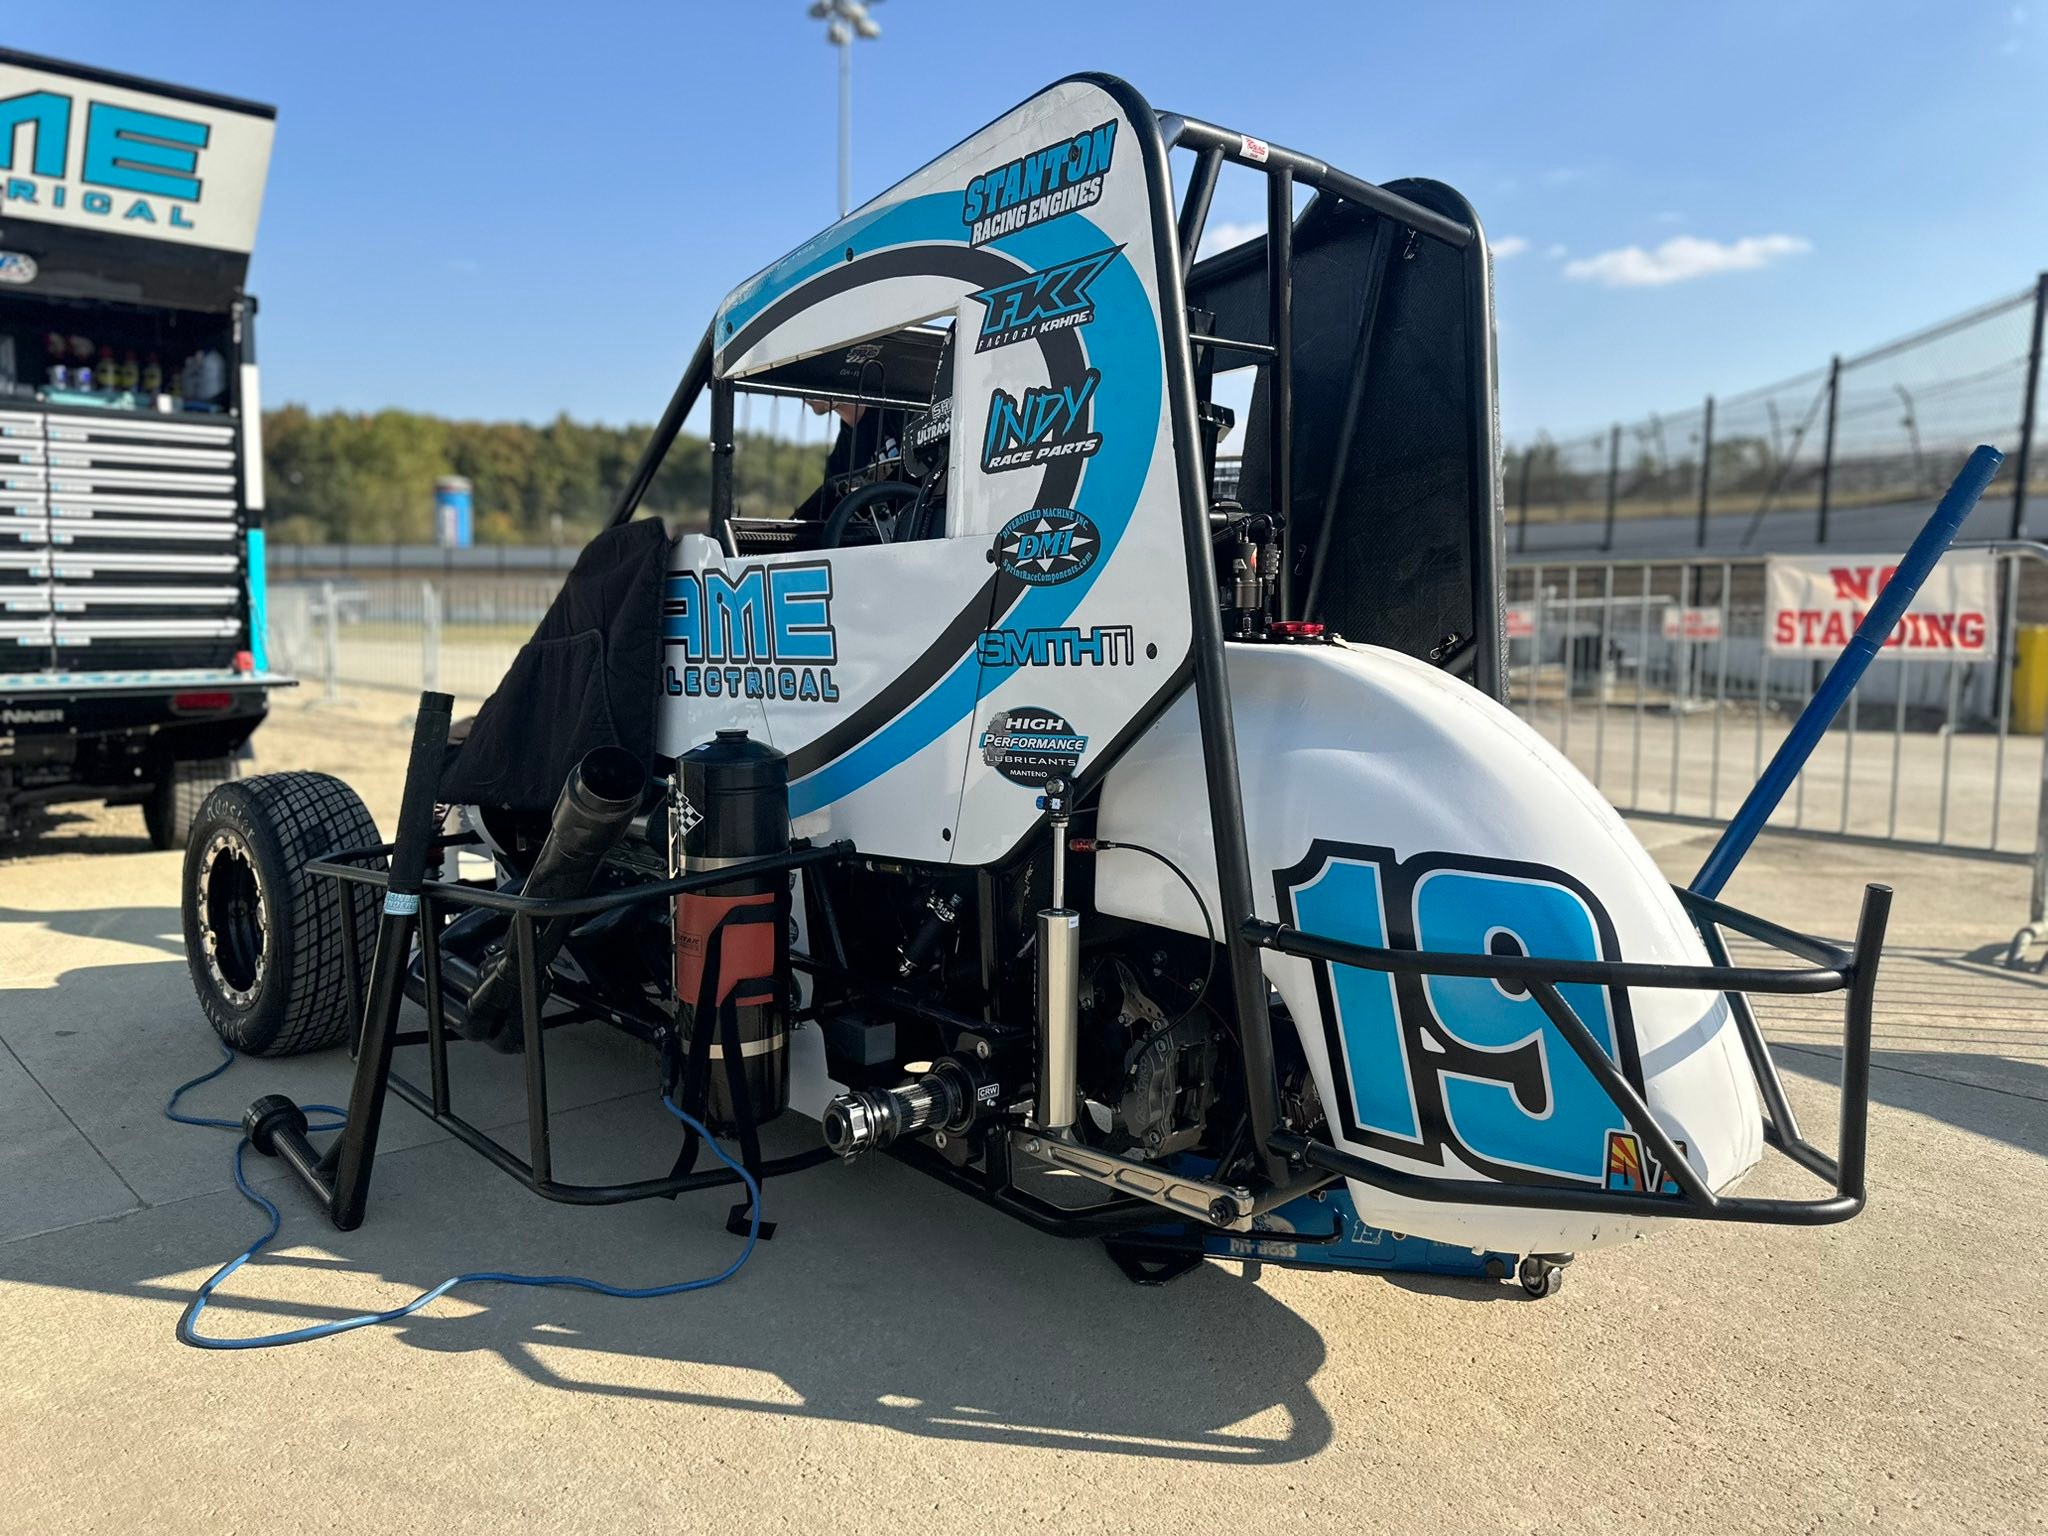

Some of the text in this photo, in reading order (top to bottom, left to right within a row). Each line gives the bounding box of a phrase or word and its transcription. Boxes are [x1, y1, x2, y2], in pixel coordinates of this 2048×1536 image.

[963, 119, 1117, 224] STANTON
[971, 176, 1102, 246] RACING ENGINES
[978, 310, 1091, 351] FACTORY KAHNE
[985, 375, 1096, 464] INDY
[988, 438, 1099, 469] RACE PARTS
[1002, 508, 1041, 540] DIVERSIFIED
[1042, 507, 1075, 521] MACHINE
[1016, 529, 1076, 560] DMI
[1002, 551, 1094, 584] SprintRaceComponents.com
[1775, 610, 1986, 649] STADING
[660, 665, 840, 703] LECTRICAL
[1005, 717, 1064, 731] HIGH
[983, 735, 1085, 751] PERFORMANCE
[986, 754, 1076, 767] LUBRICANTS
[1010, 769, 1048, 778] MANTENO
[1272, 838, 1650, 1190] 19
[980, 1086, 998, 1098] CRW
[1229, 1238, 1297, 1258] PIT BOSS
